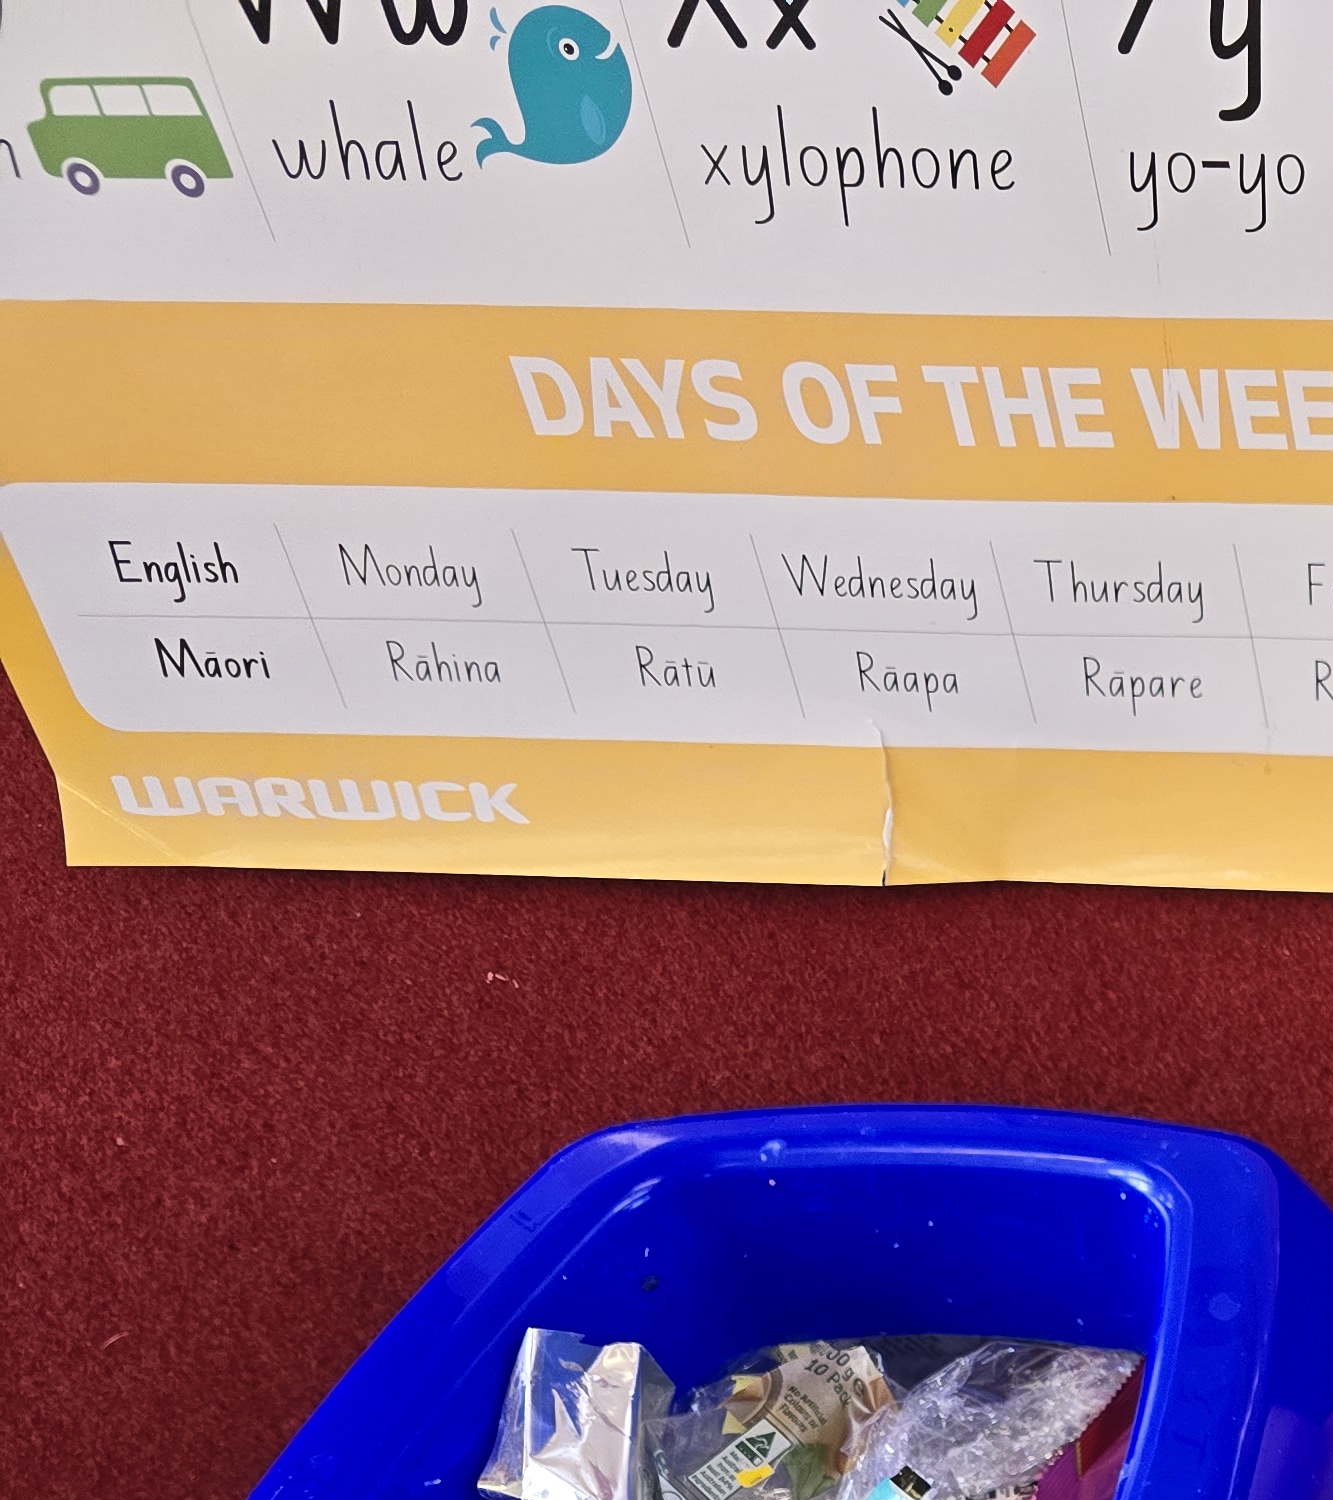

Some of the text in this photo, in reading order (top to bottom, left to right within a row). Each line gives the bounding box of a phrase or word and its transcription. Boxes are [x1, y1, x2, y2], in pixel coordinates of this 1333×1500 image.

[272, 100, 462, 181] whale
[701, 105, 1014, 226] xylophone
[1130, 152, 1304, 232] yo-yo
[509, 356, 757, 441] DAYS
[782, 362, 902, 444] OF
[921, 365, 1114, 448] THE
[108, 541, 238, 603] English
[339, 544, 482, 607] Monday
[571, 548, 714, 613] Tuesday
[782, 554, 977, 620] Wednesday
[1034, 560, 1203, 623] Thursday
[154, 638, 270, 678] Māori
[386, 641, 500, 682] Rāhina
[636, 646, 715, 687] Rātū
[856, 651, 958, 711] Rāapa
[1083, 657, 1202, 716] Rāpare
[111, 776, 530, 824] WARWICK
[804, 1359, 829, 1375] 10
